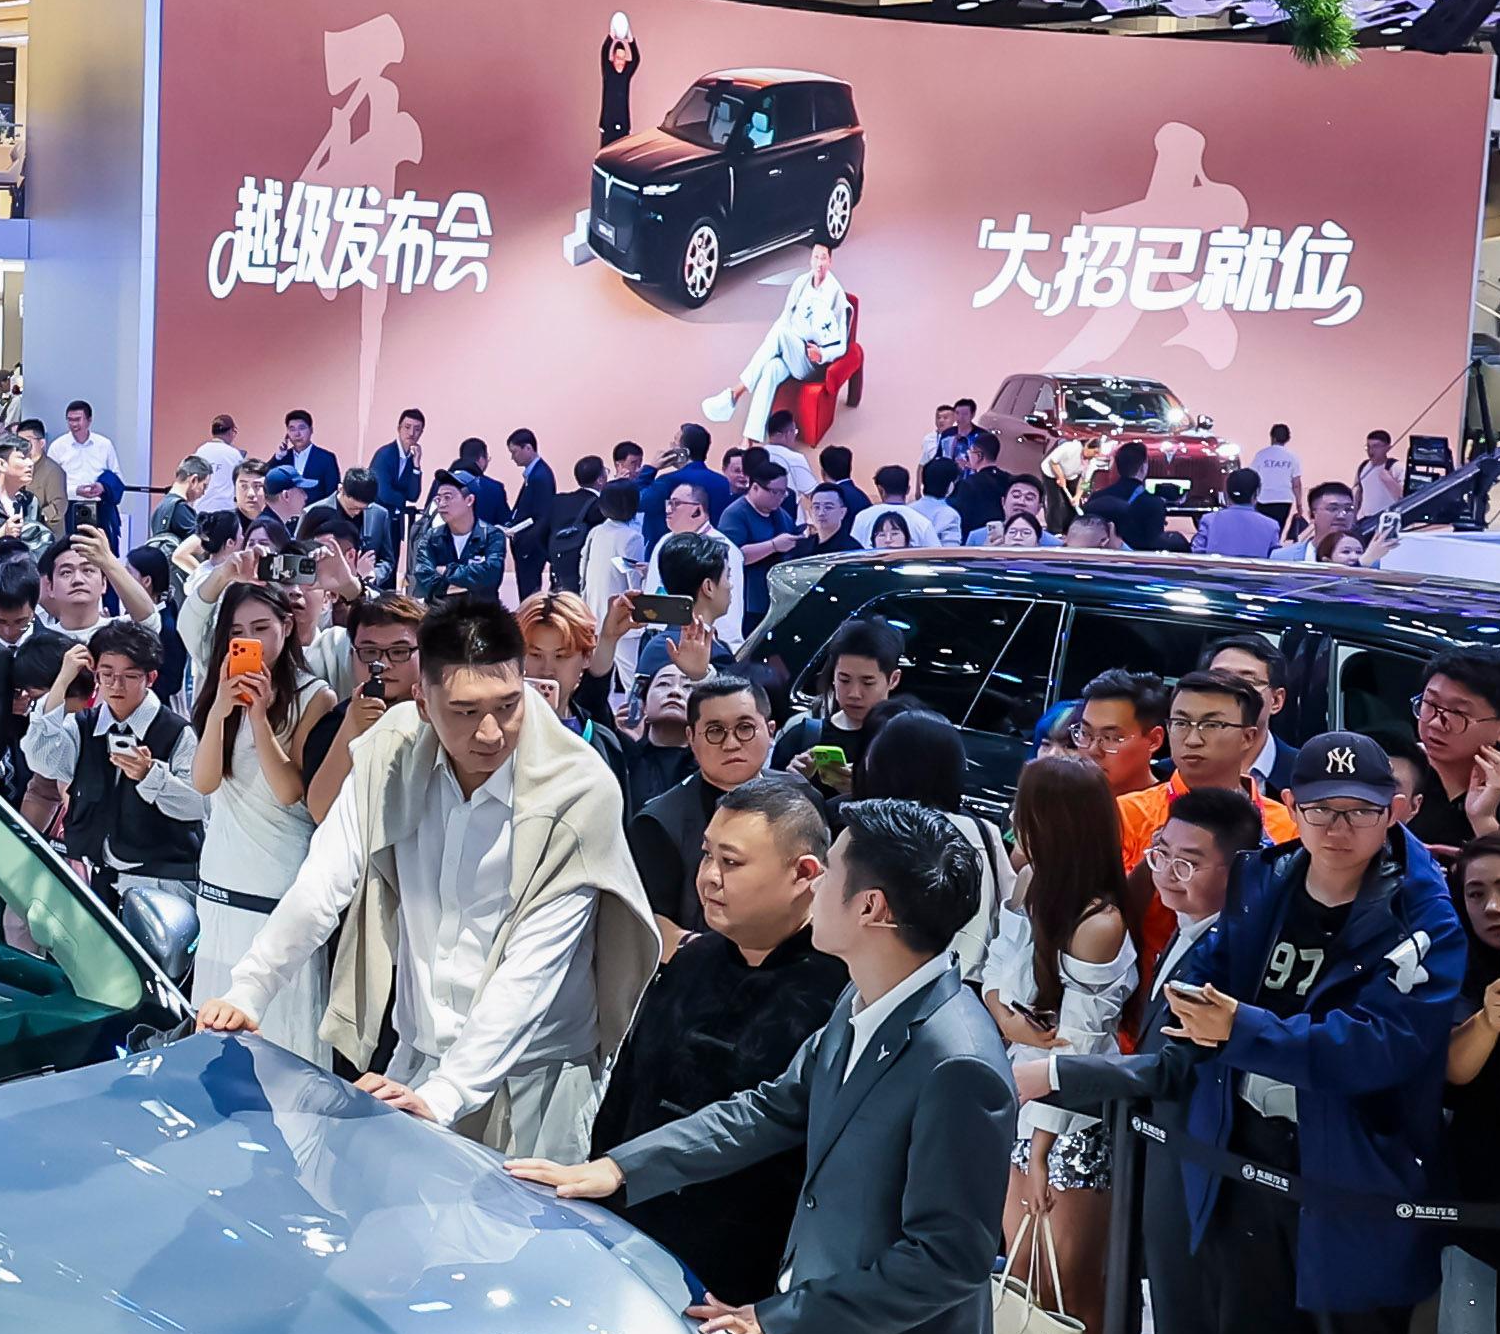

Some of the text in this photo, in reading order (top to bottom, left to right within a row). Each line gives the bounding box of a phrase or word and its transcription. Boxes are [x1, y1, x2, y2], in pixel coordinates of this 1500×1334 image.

[208, 173, 490, 299] 越级发布会
[1264, 942, 1324, 996] 97
